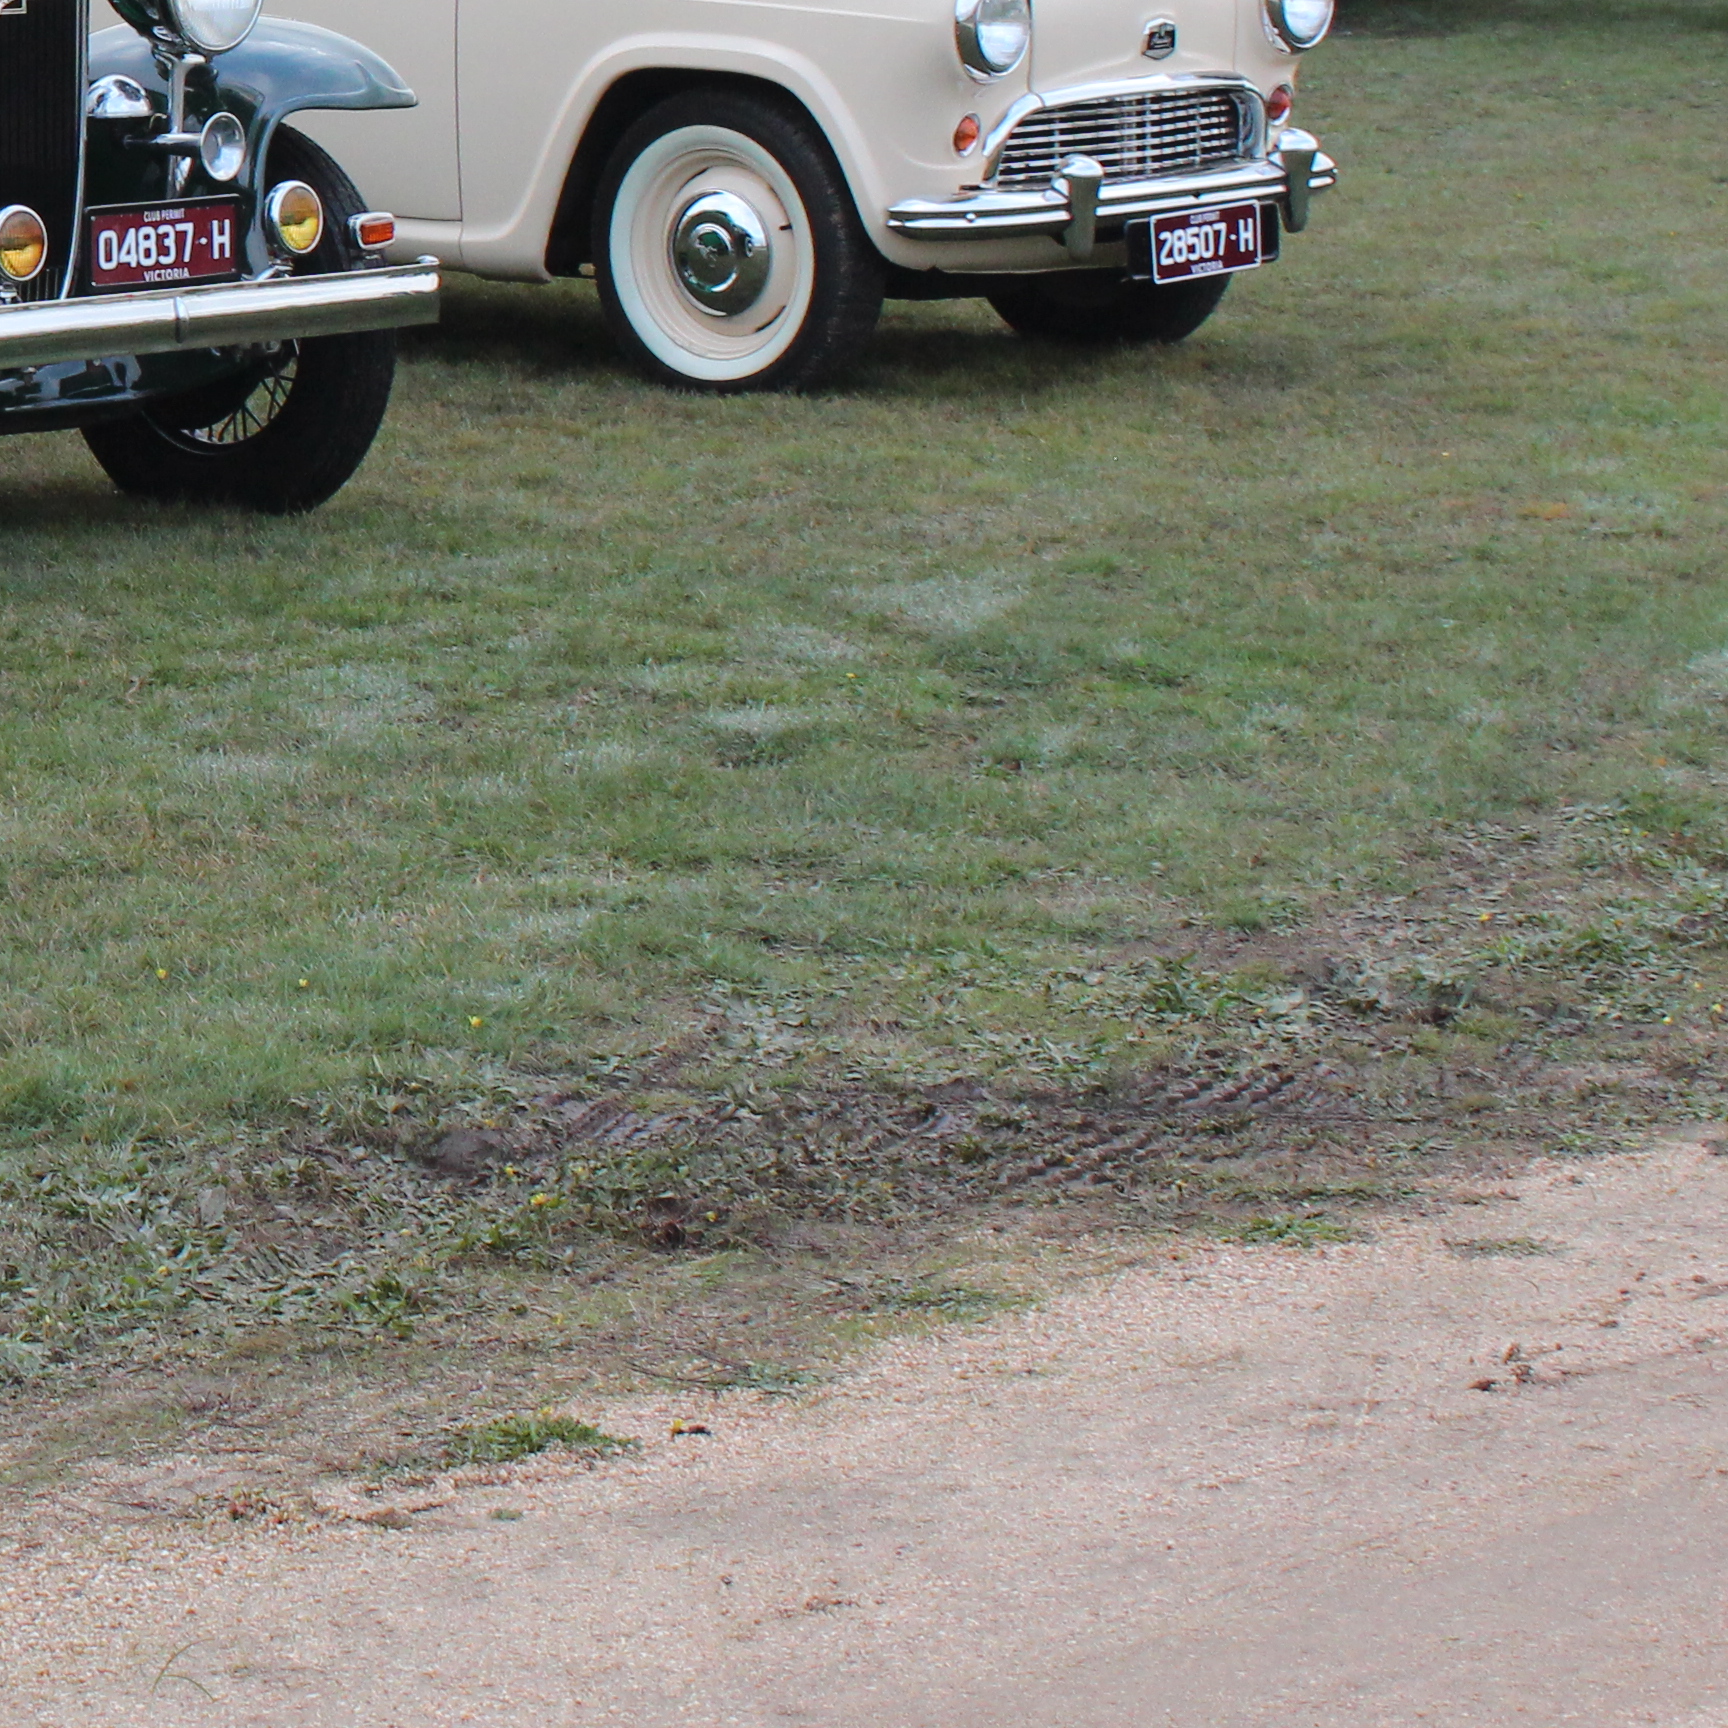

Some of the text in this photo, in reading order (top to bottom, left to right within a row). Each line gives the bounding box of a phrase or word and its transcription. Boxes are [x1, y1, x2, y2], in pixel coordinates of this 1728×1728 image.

[144, 208, 185, 222] CLUB PERMIT
[143, 267, 190, 282] VICTORIA
